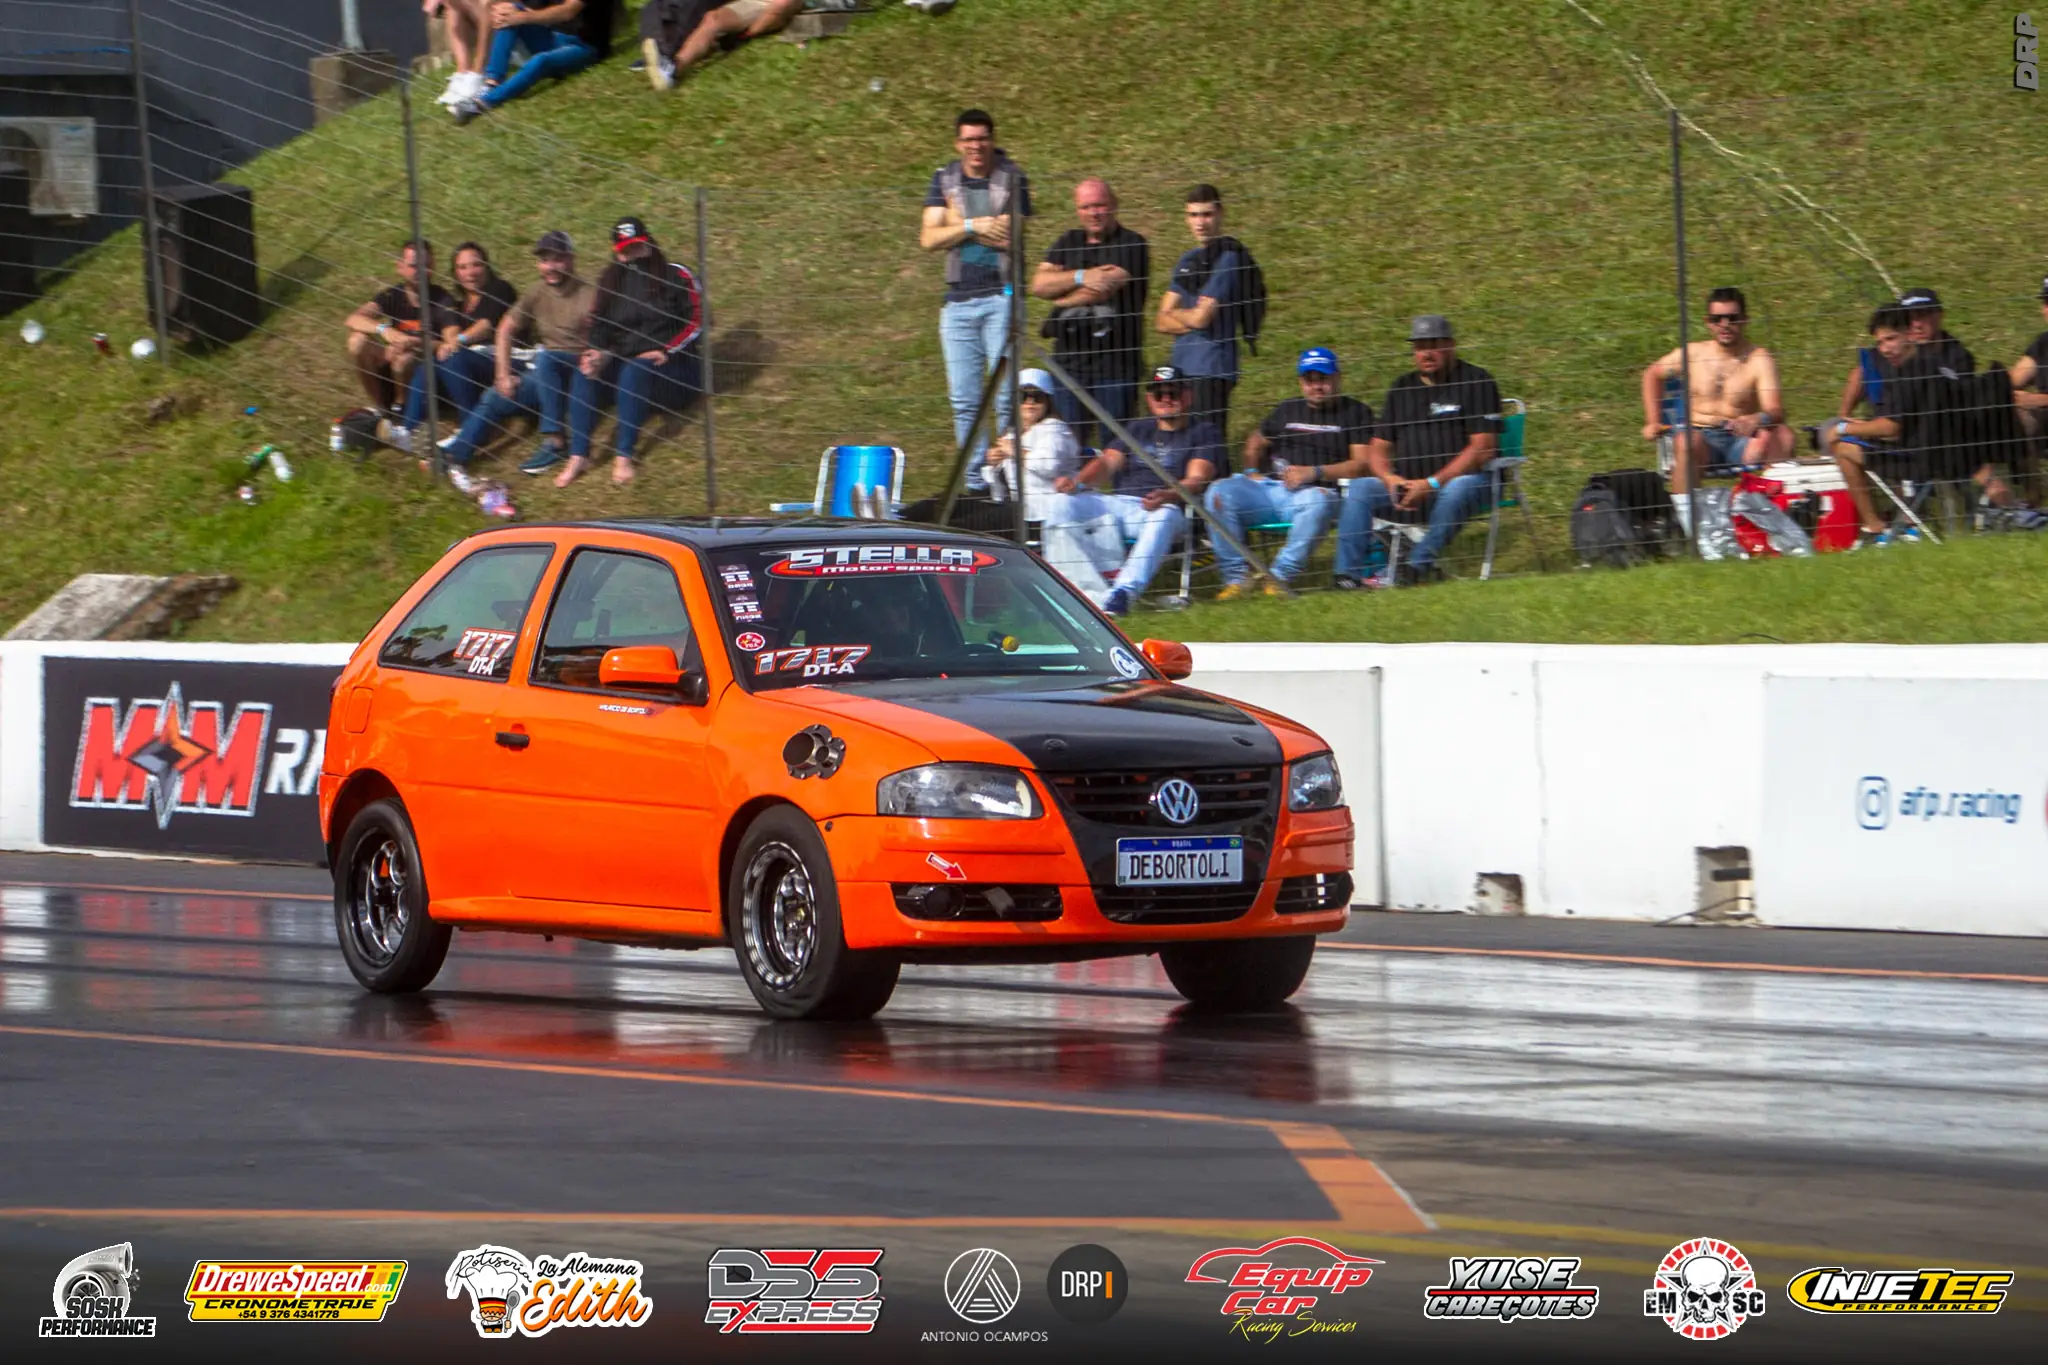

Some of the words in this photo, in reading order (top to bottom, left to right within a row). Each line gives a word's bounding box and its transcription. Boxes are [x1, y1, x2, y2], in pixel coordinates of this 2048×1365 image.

[789, 546, 973, 568] STELLA
[453, 627, 517, 659] 1717
[467, 656, 495, 675] DT-A
[755, 645, 871, 675] 1717
[803, 662, 854, 677] DT-A
[1899, 785, 2022, 824] afp.racing
[1129, 852, 1230, 880] DEBORTOLI
